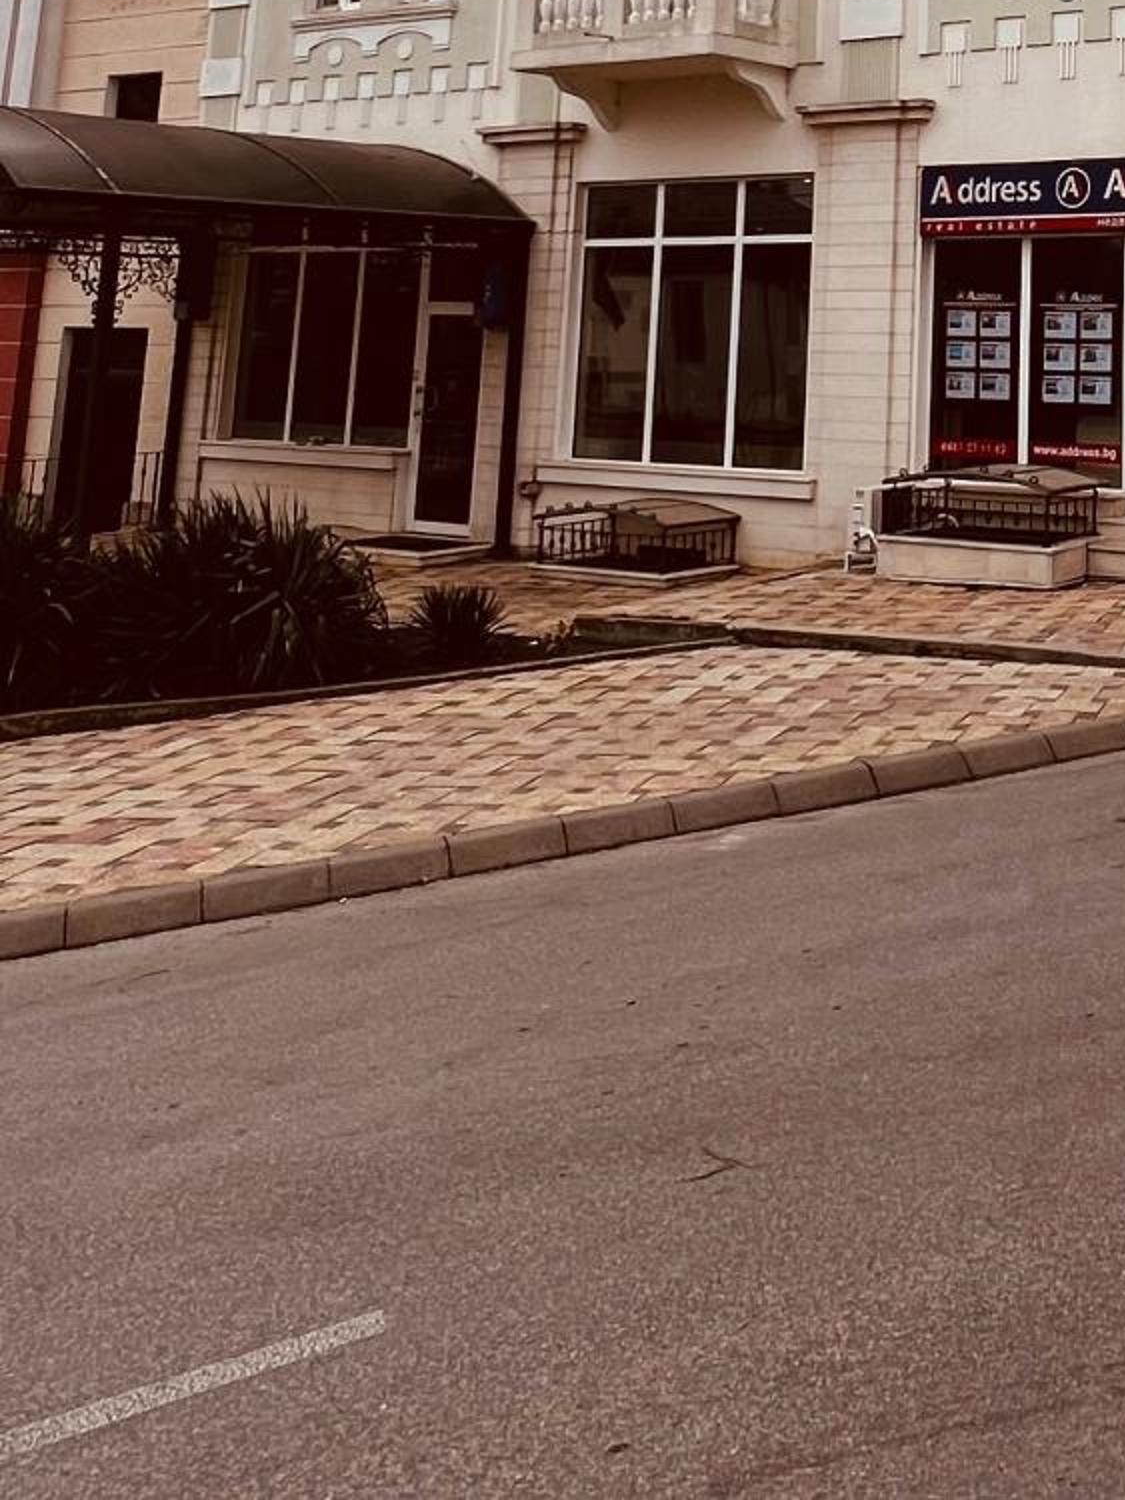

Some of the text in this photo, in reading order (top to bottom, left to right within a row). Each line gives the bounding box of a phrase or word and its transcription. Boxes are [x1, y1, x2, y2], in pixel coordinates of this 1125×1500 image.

[930, 174, 1042, 206] Address
[926, 219, 1037, 232] real estate
[1032, 443, 1117, 462] www.address.bg
